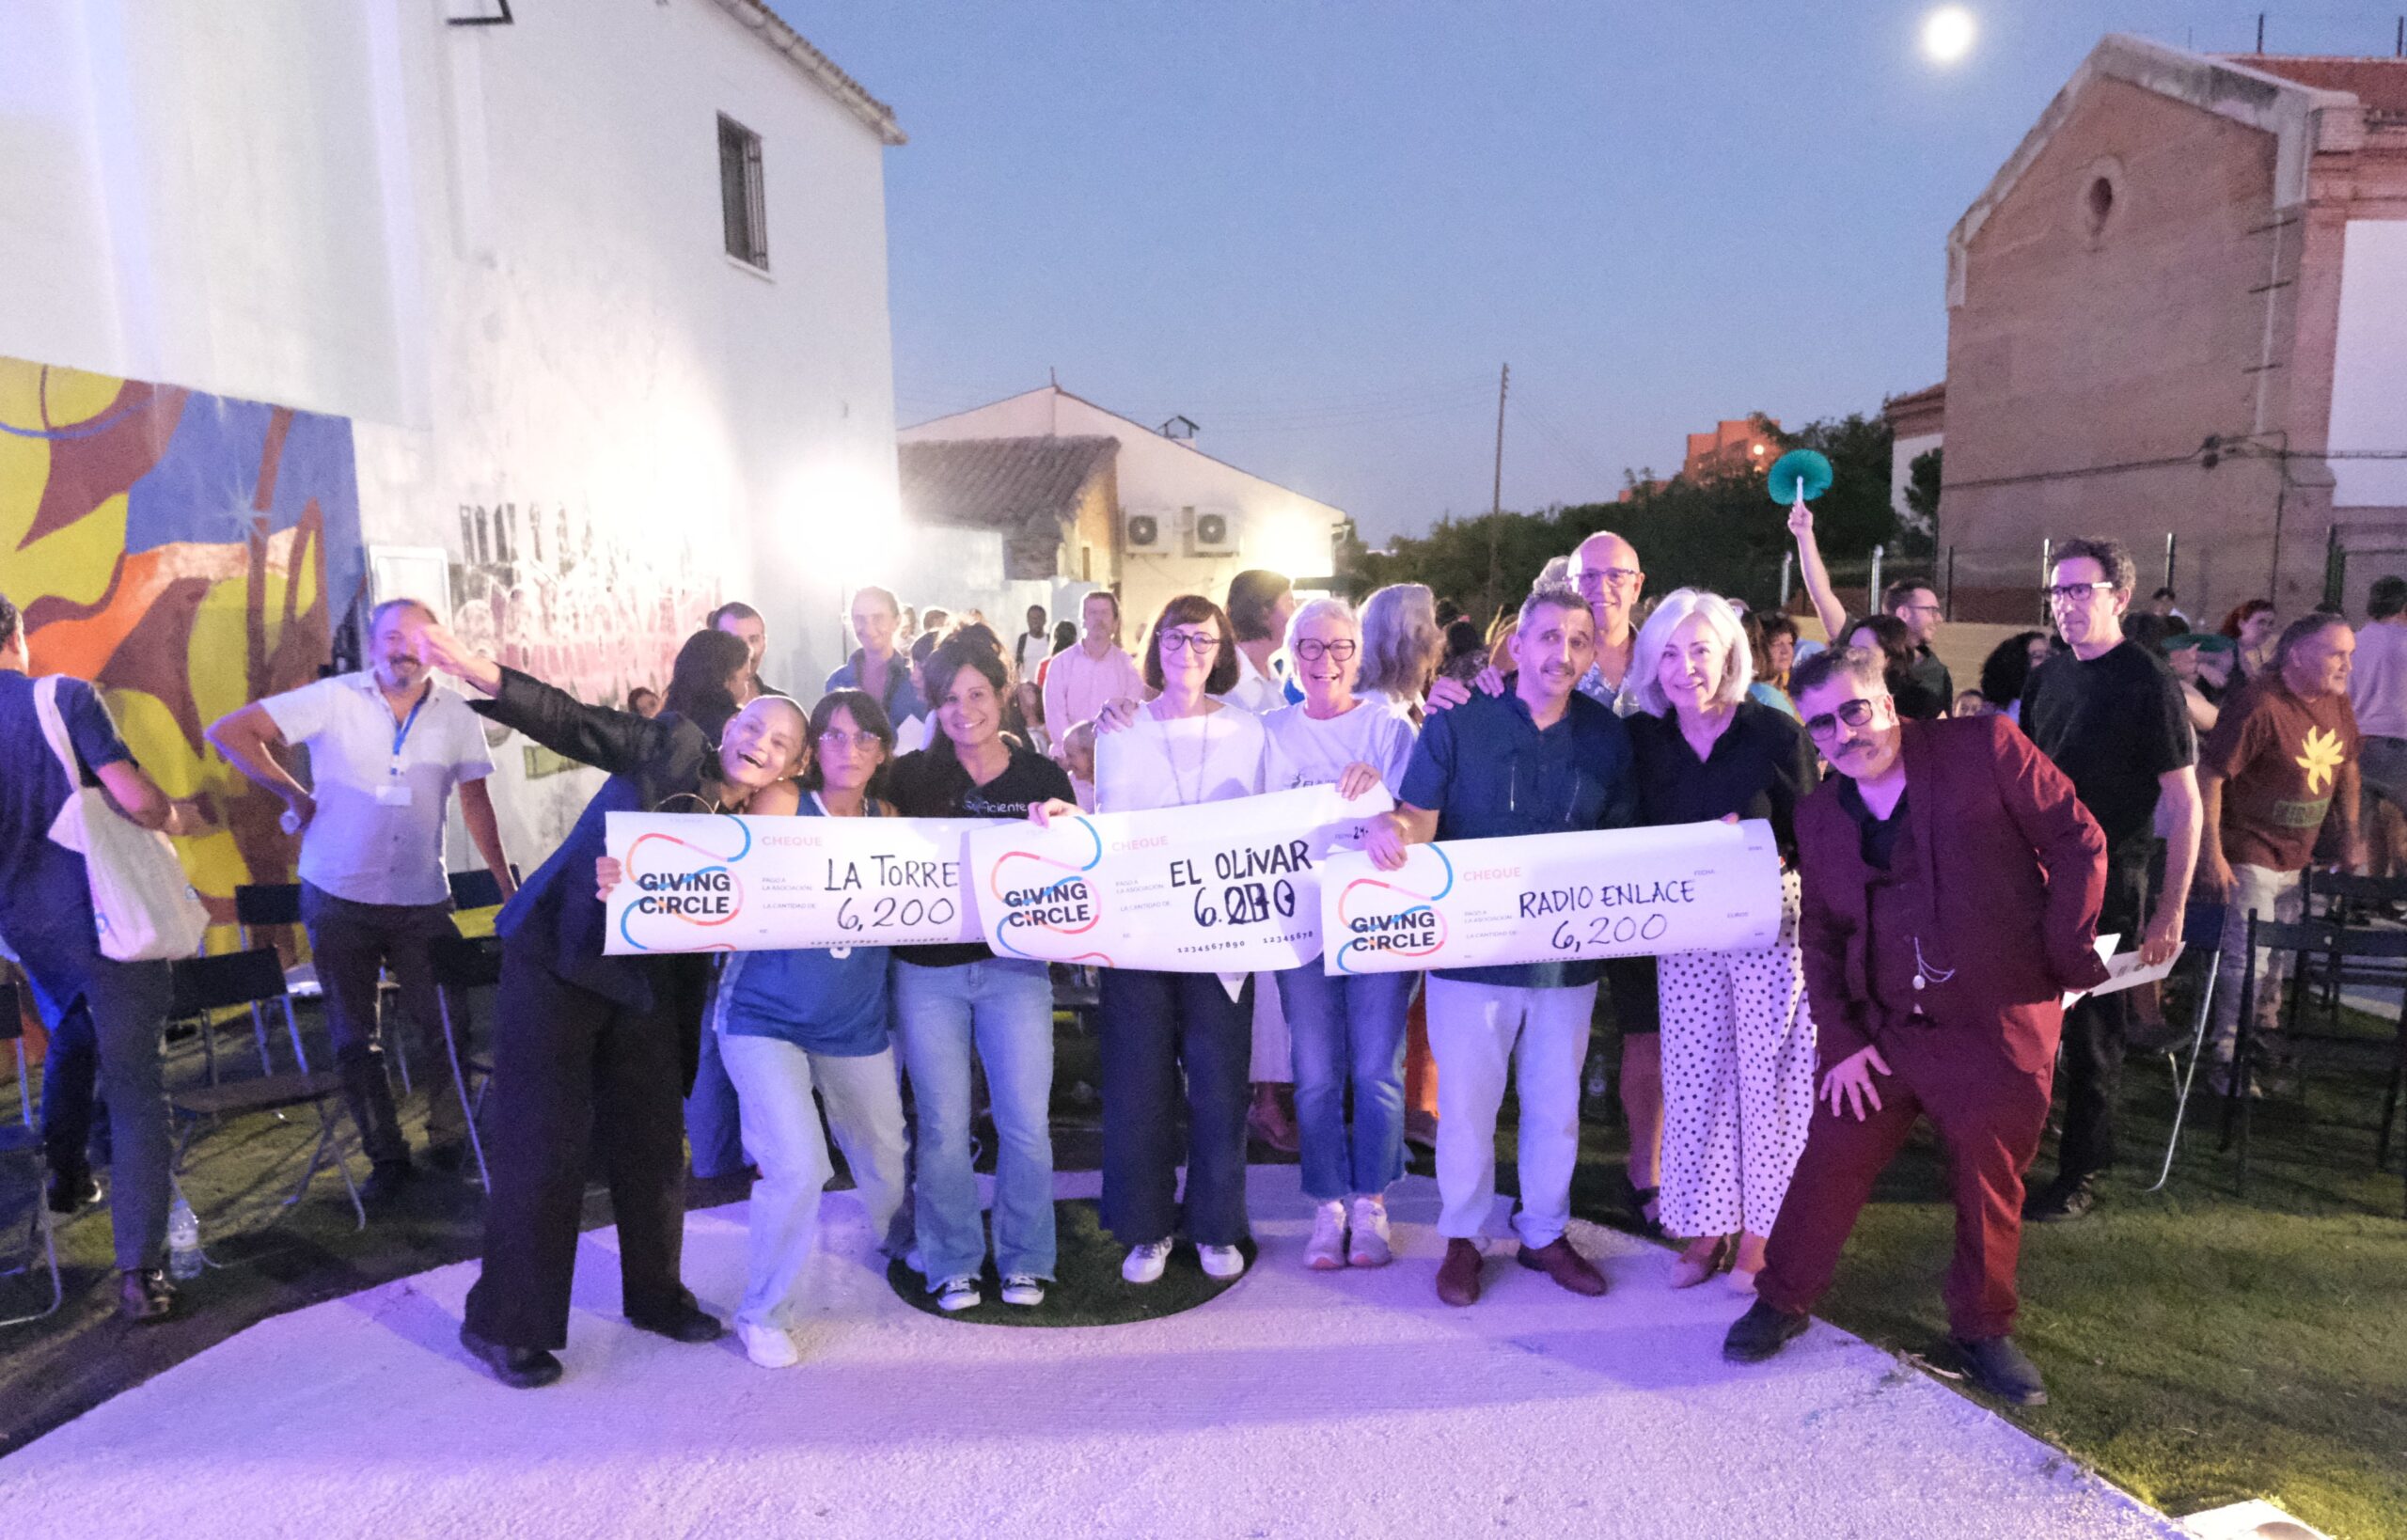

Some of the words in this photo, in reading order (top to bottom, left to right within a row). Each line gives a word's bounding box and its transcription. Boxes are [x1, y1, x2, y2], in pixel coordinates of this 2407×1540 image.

[761, 836, 823, 847] CHEQUE
[1111, 835, 1170, 852] CHEQUE
[637, 872, 731, 892] GIVING
[825, 857, 862, 891] LA
[1170, 858, 1203, 888] EL
[1463, 867, 1521, 882] CHEQUE
[638, 896, 730, 915] CIRCLE
[1003, 883, 1089, 908] GIVING
[1519, 886, 1594, 918] RADIO
[1600, 880, 1694, 907] ENLACE
[837, 897, 954, 932] 6,200
[1008, 904, 1091, 928] CIRCLE
[1350, 912, 1435, 933] GIVING
[1177, 941, 1245, 953] 1234567890
[1263, 931, 1314, 944] 12345678
[1352, 932, 1435, 951] CIRCLE
[1551, 914, 1667, 952] 6,200
